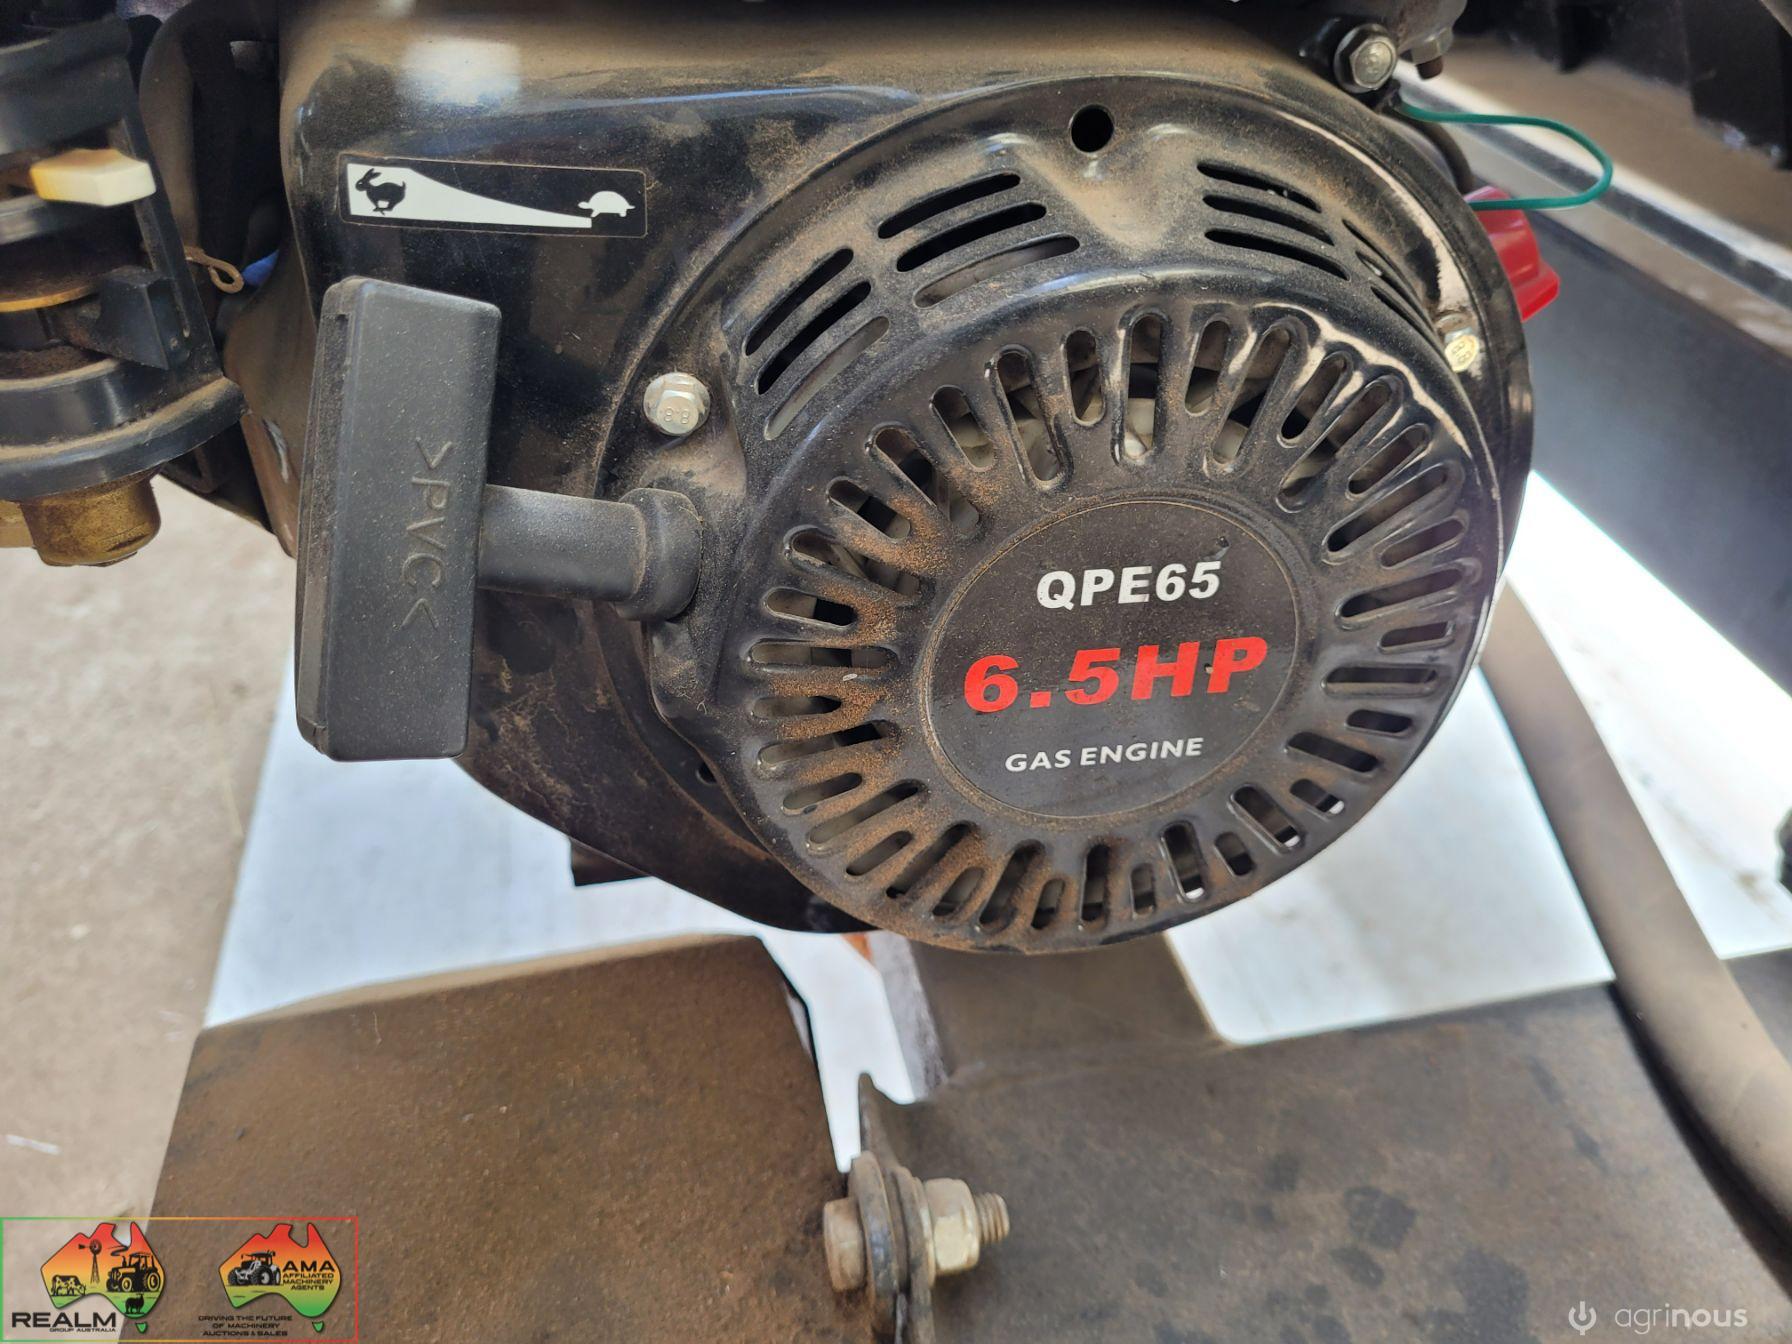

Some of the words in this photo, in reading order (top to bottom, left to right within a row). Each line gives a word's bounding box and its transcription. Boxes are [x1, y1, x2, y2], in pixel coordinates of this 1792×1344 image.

[1036, 561, 1222, 611] QPE65
[963, 635, 1268, 713] 6.5HP
[1004, 746, 1072, 772] GAS
[1079, 737, 1205, 766] ENGINE
